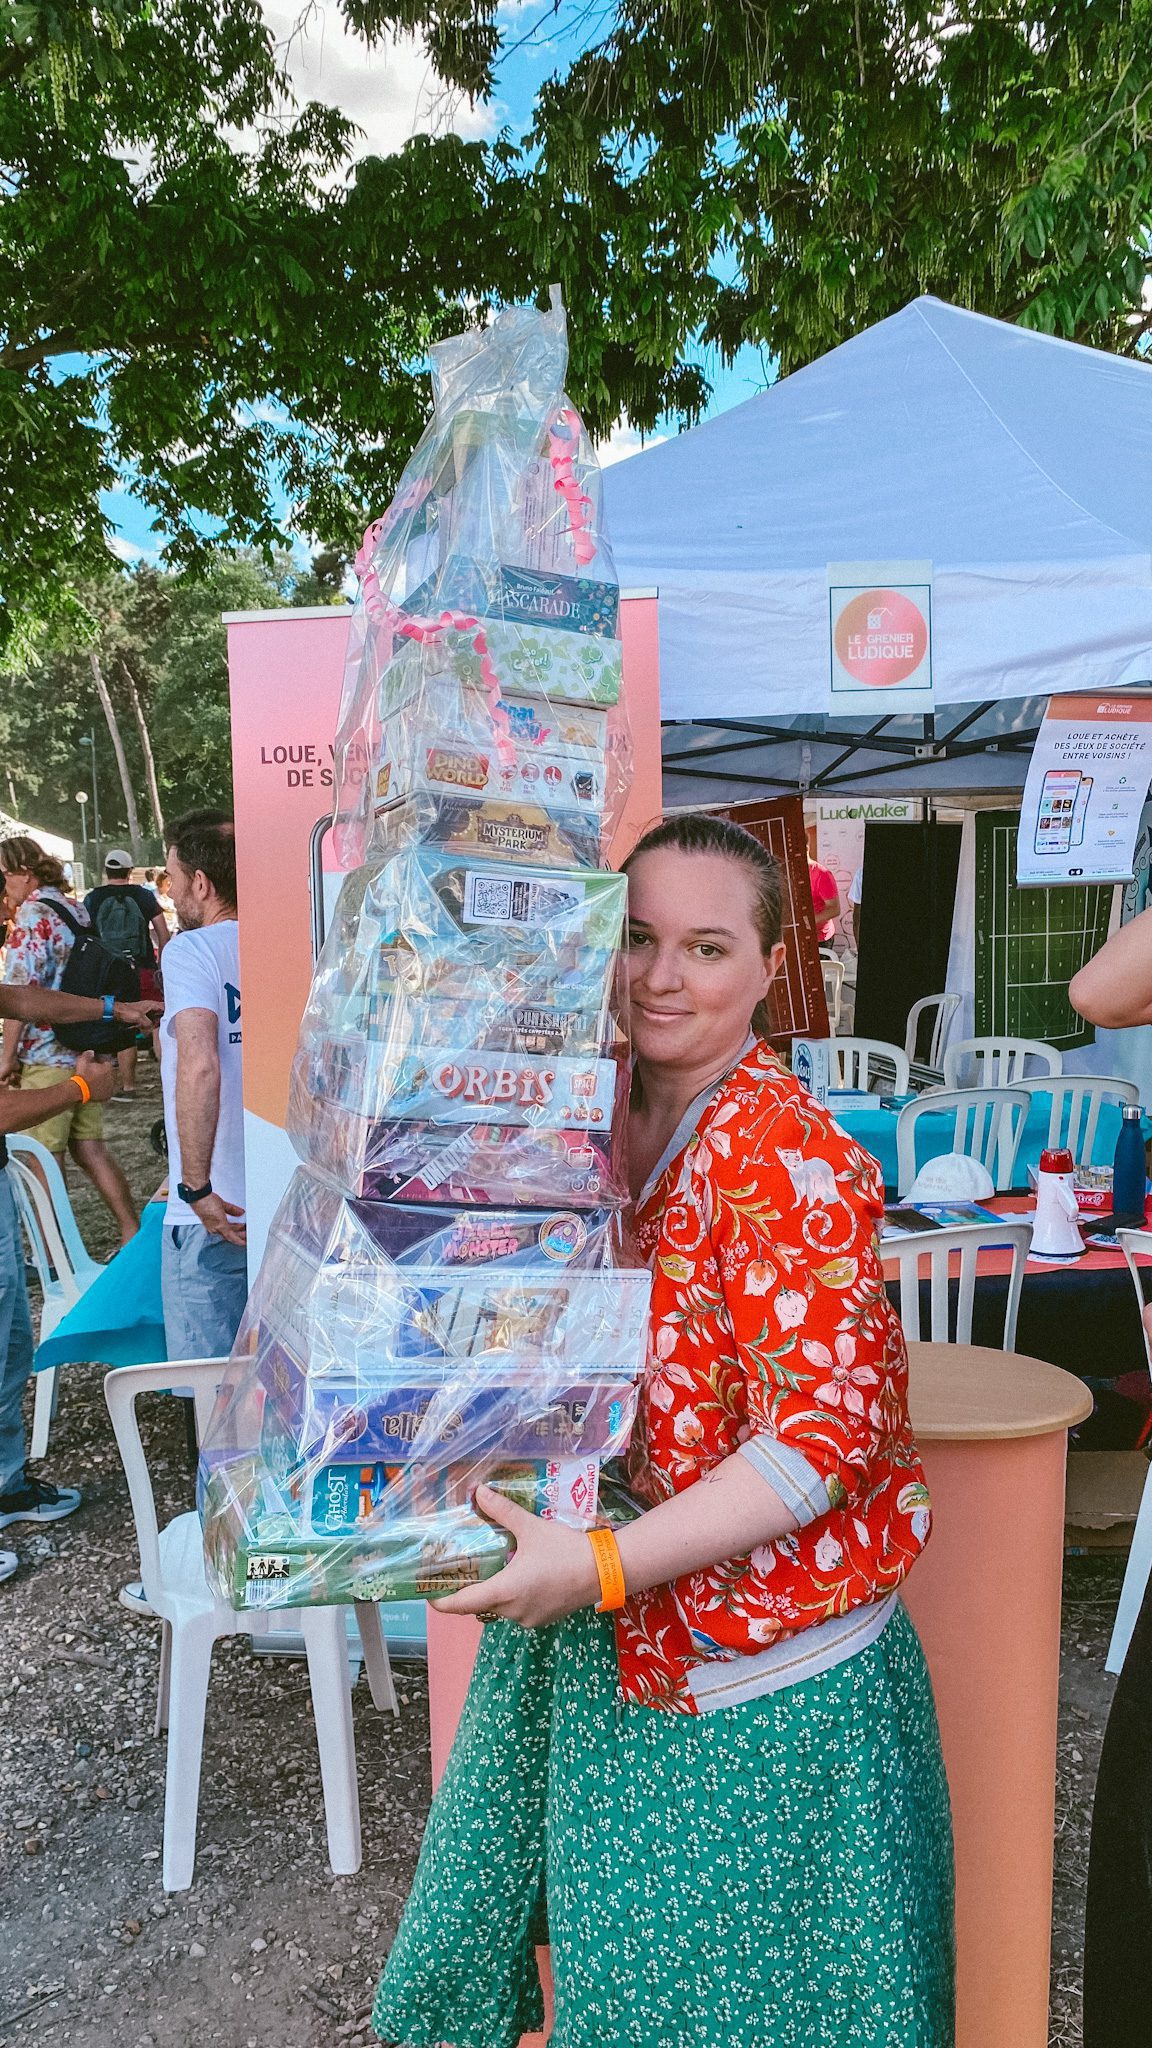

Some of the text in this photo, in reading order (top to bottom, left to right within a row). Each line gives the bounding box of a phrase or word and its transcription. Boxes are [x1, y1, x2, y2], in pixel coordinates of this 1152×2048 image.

[847, 632, 914, 645] LE GRENIER
[847, 644, 914, 660] LUDIQUE
[1067, 732, 1140, 741] LOUE ET ACHÈTE
[260, 745, 323, 767] LOUE,
[1053, 742, 1147, 751] DES JEUX DE SOCIÉTÉ
[1062, 752, 1091, 760] ENTRE
[1092, 752, 1126, 760] VOISINS
[435, 751, 480, 770] DINO
[287, 769, 314, 787] DE
[426, 765, 490, 786] WORLD
[482, 822, 544, 842] MYSTERIUM
[497, 836, 528, 850] PARK
[431, 1063, 556, 1105] ORBIS
[442, 1237, 519, 1260] MONSTER
[585, 1463, 596, 1513] PINBOARD
[324, 1468, 347, 1532] GHOST
